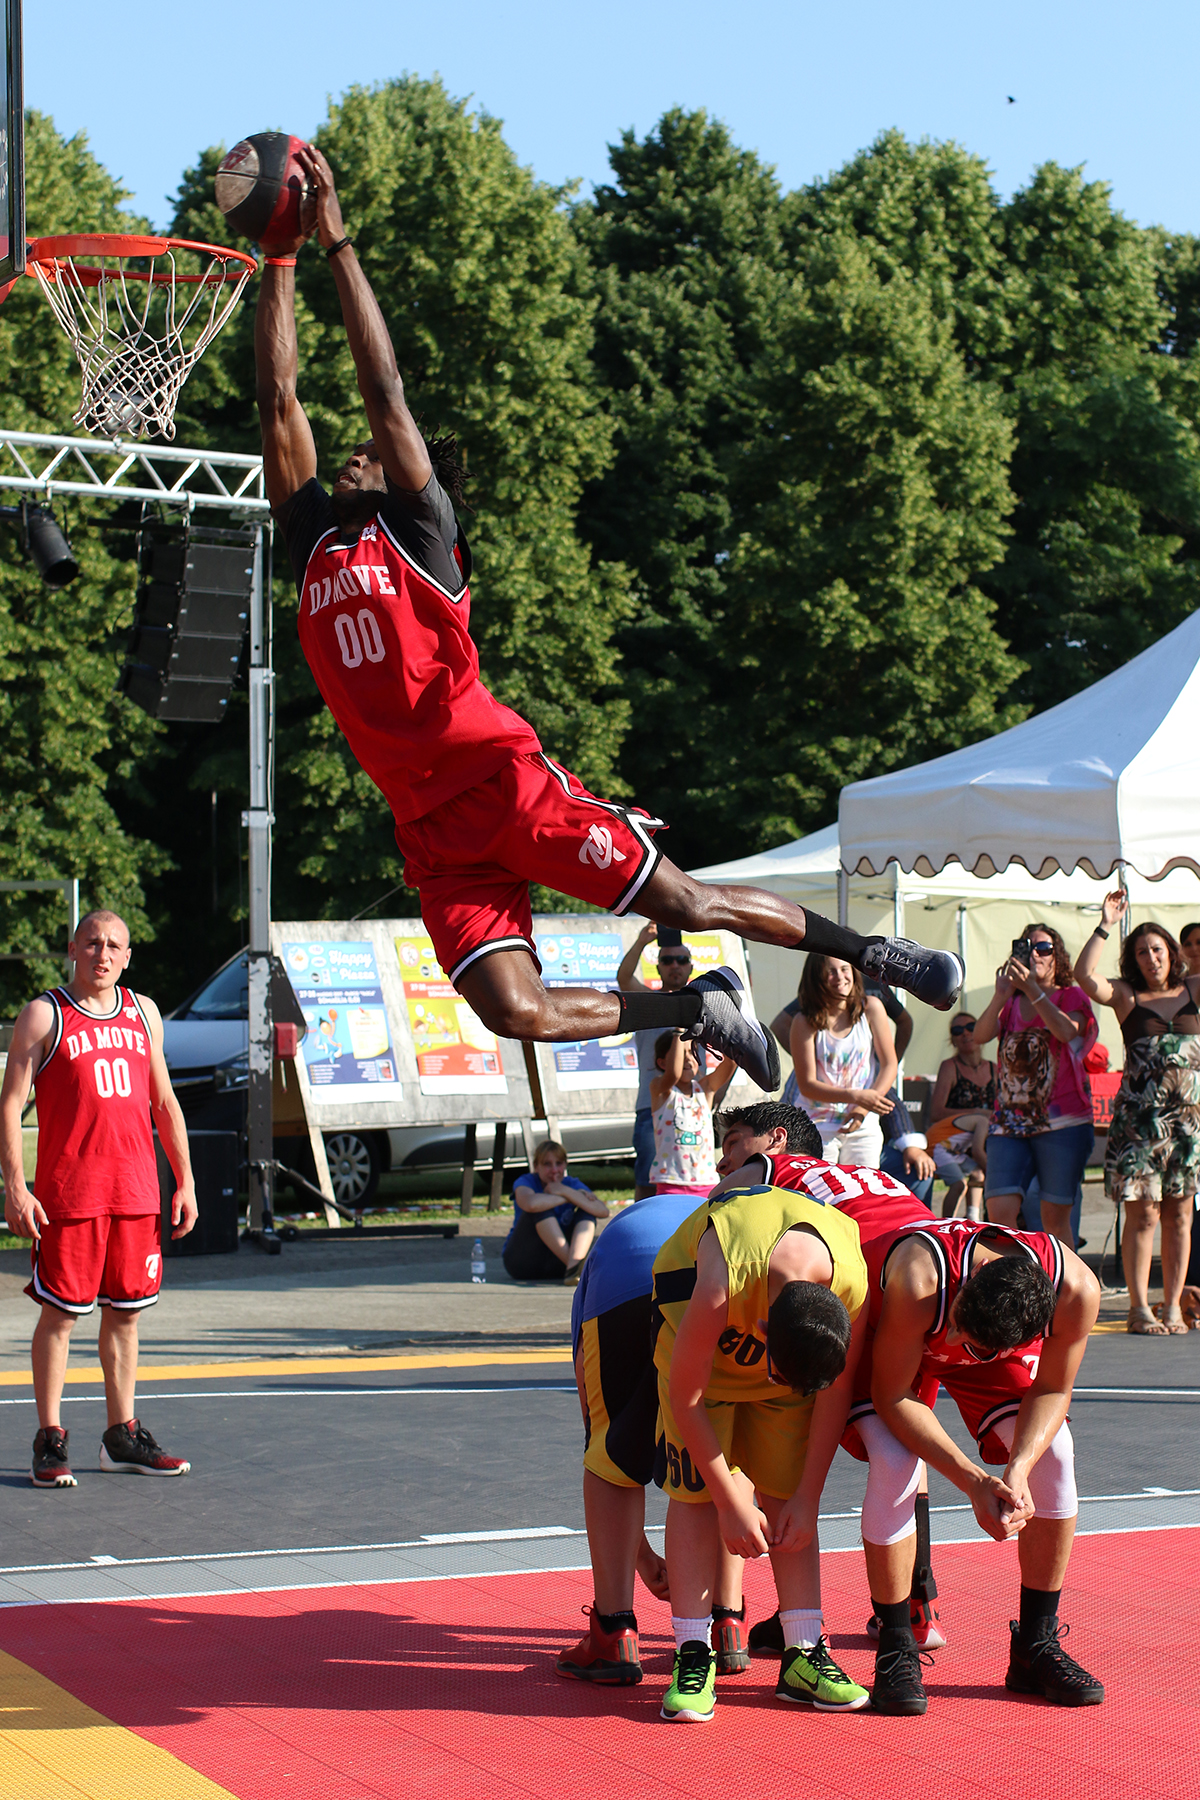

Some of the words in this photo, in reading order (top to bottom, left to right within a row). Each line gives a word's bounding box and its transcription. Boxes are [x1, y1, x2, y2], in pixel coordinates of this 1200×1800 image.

[333, 564, 397, 604] MOVE
[334, 607, 386, 669] 00
[328, 950, 374, 968] Happy
[578, 942, 621, 960] Happy
[339, 967, 377, 980] Piazza
[66, 1030, 93, 1060] DA
[94, 1026, 146, 1056] MOVE
[94, 1058, 132, 1098] 00
[801, 1165, 911, 1205] 00
[717, 1328, 766, 1366] 60
[666, 1441, 706, 1492] 60
